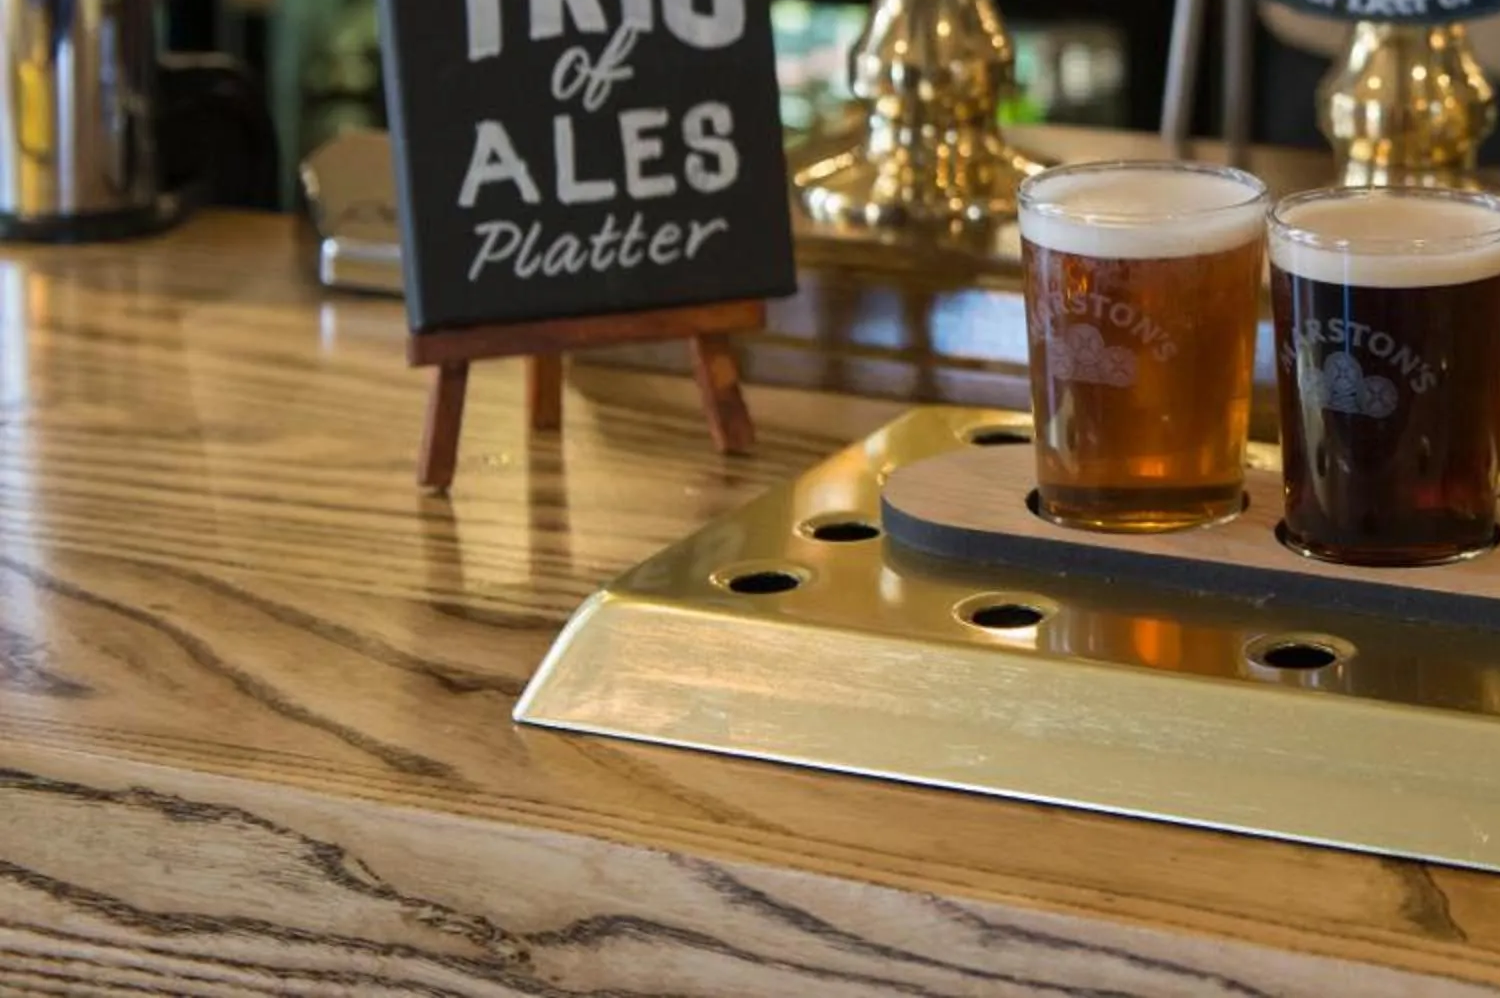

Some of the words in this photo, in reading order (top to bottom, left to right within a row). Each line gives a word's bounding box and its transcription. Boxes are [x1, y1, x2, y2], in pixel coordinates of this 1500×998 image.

[551, 19, 635, 110] of
[457, 101, 741, 208] ALES
[468, 212, 728, 281] Platter
